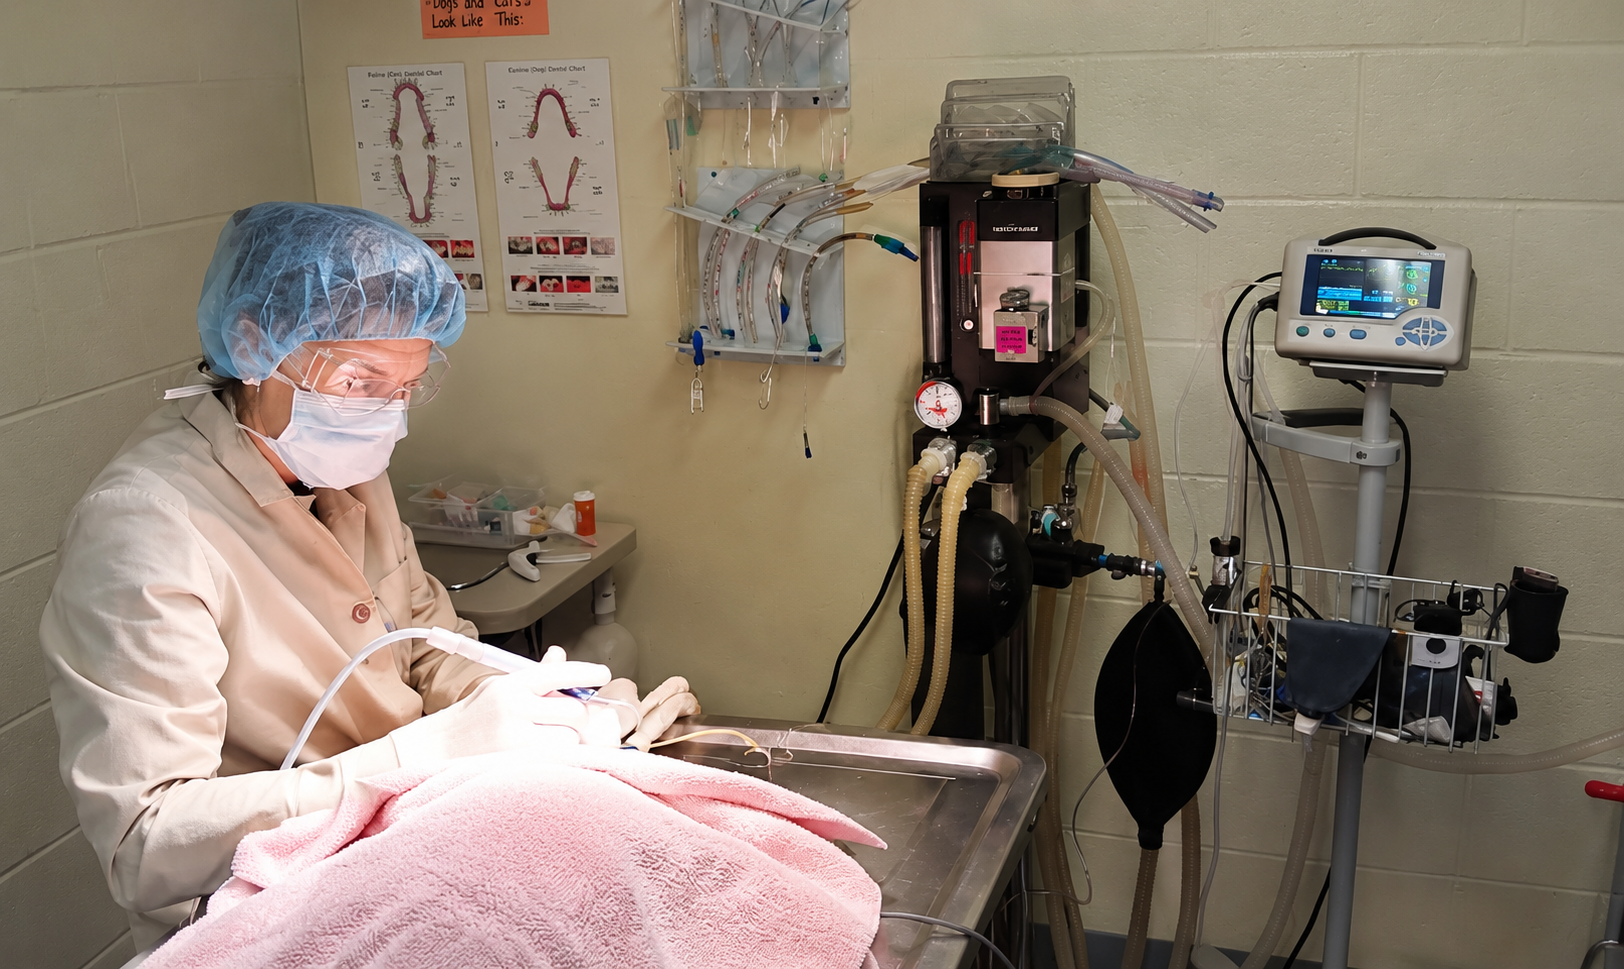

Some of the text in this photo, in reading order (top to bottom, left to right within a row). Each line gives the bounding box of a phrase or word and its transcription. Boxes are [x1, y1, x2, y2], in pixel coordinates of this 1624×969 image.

[464, 0, 484, 9] and
[432, 11, 524, 28] Look Like This:
